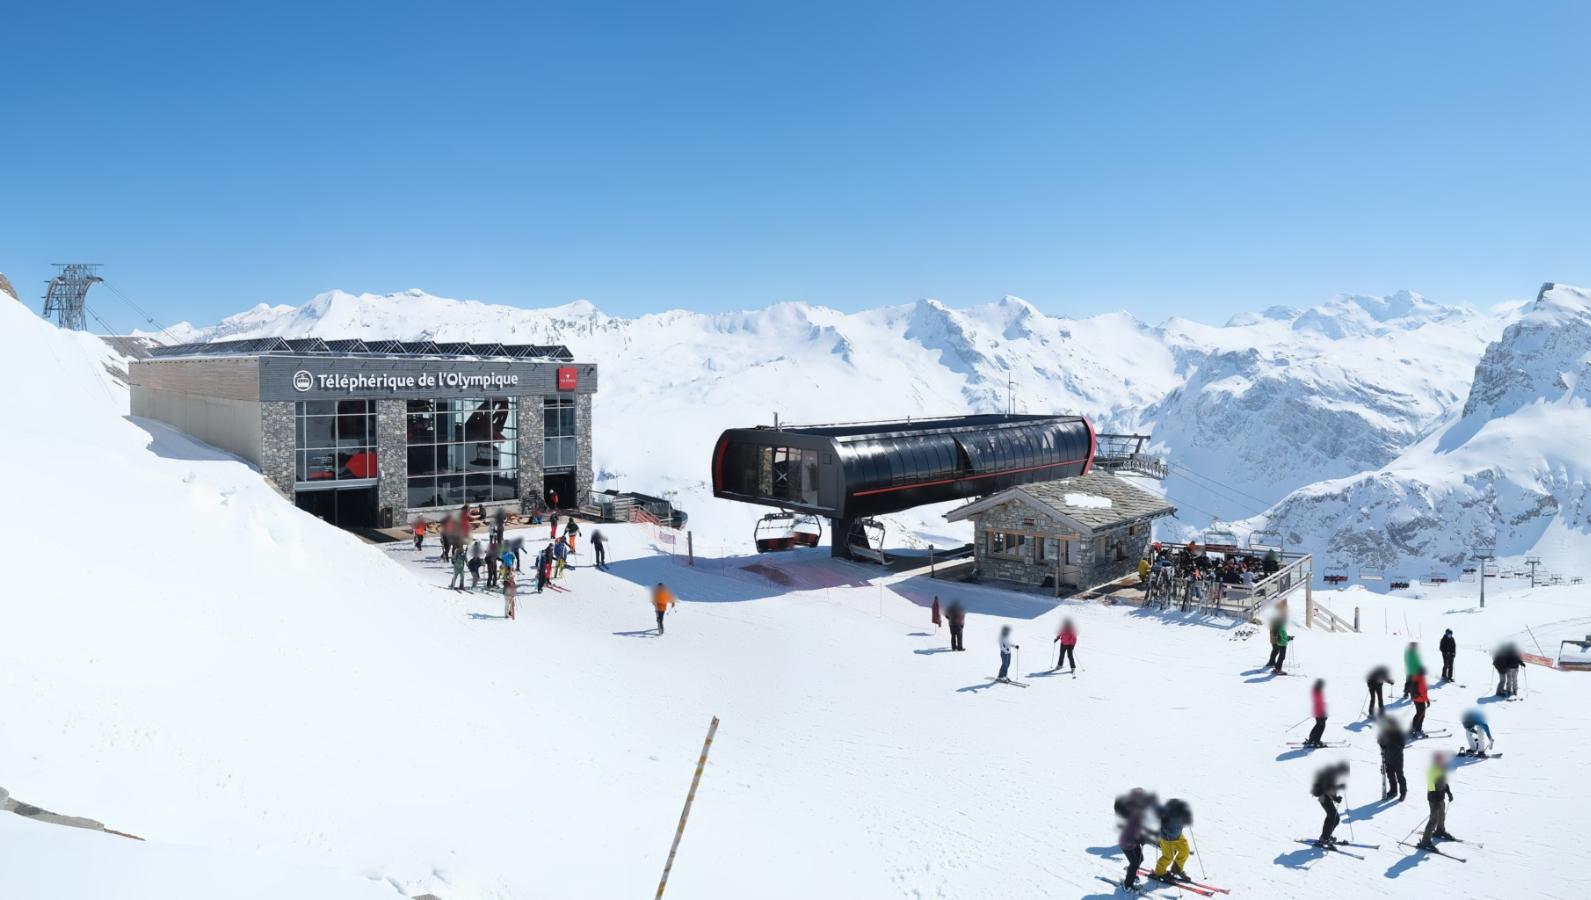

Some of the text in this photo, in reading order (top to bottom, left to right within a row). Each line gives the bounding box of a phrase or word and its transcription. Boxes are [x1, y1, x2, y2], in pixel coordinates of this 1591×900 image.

[317, 372, 519, 391] Téléphérique de l'Olympique
